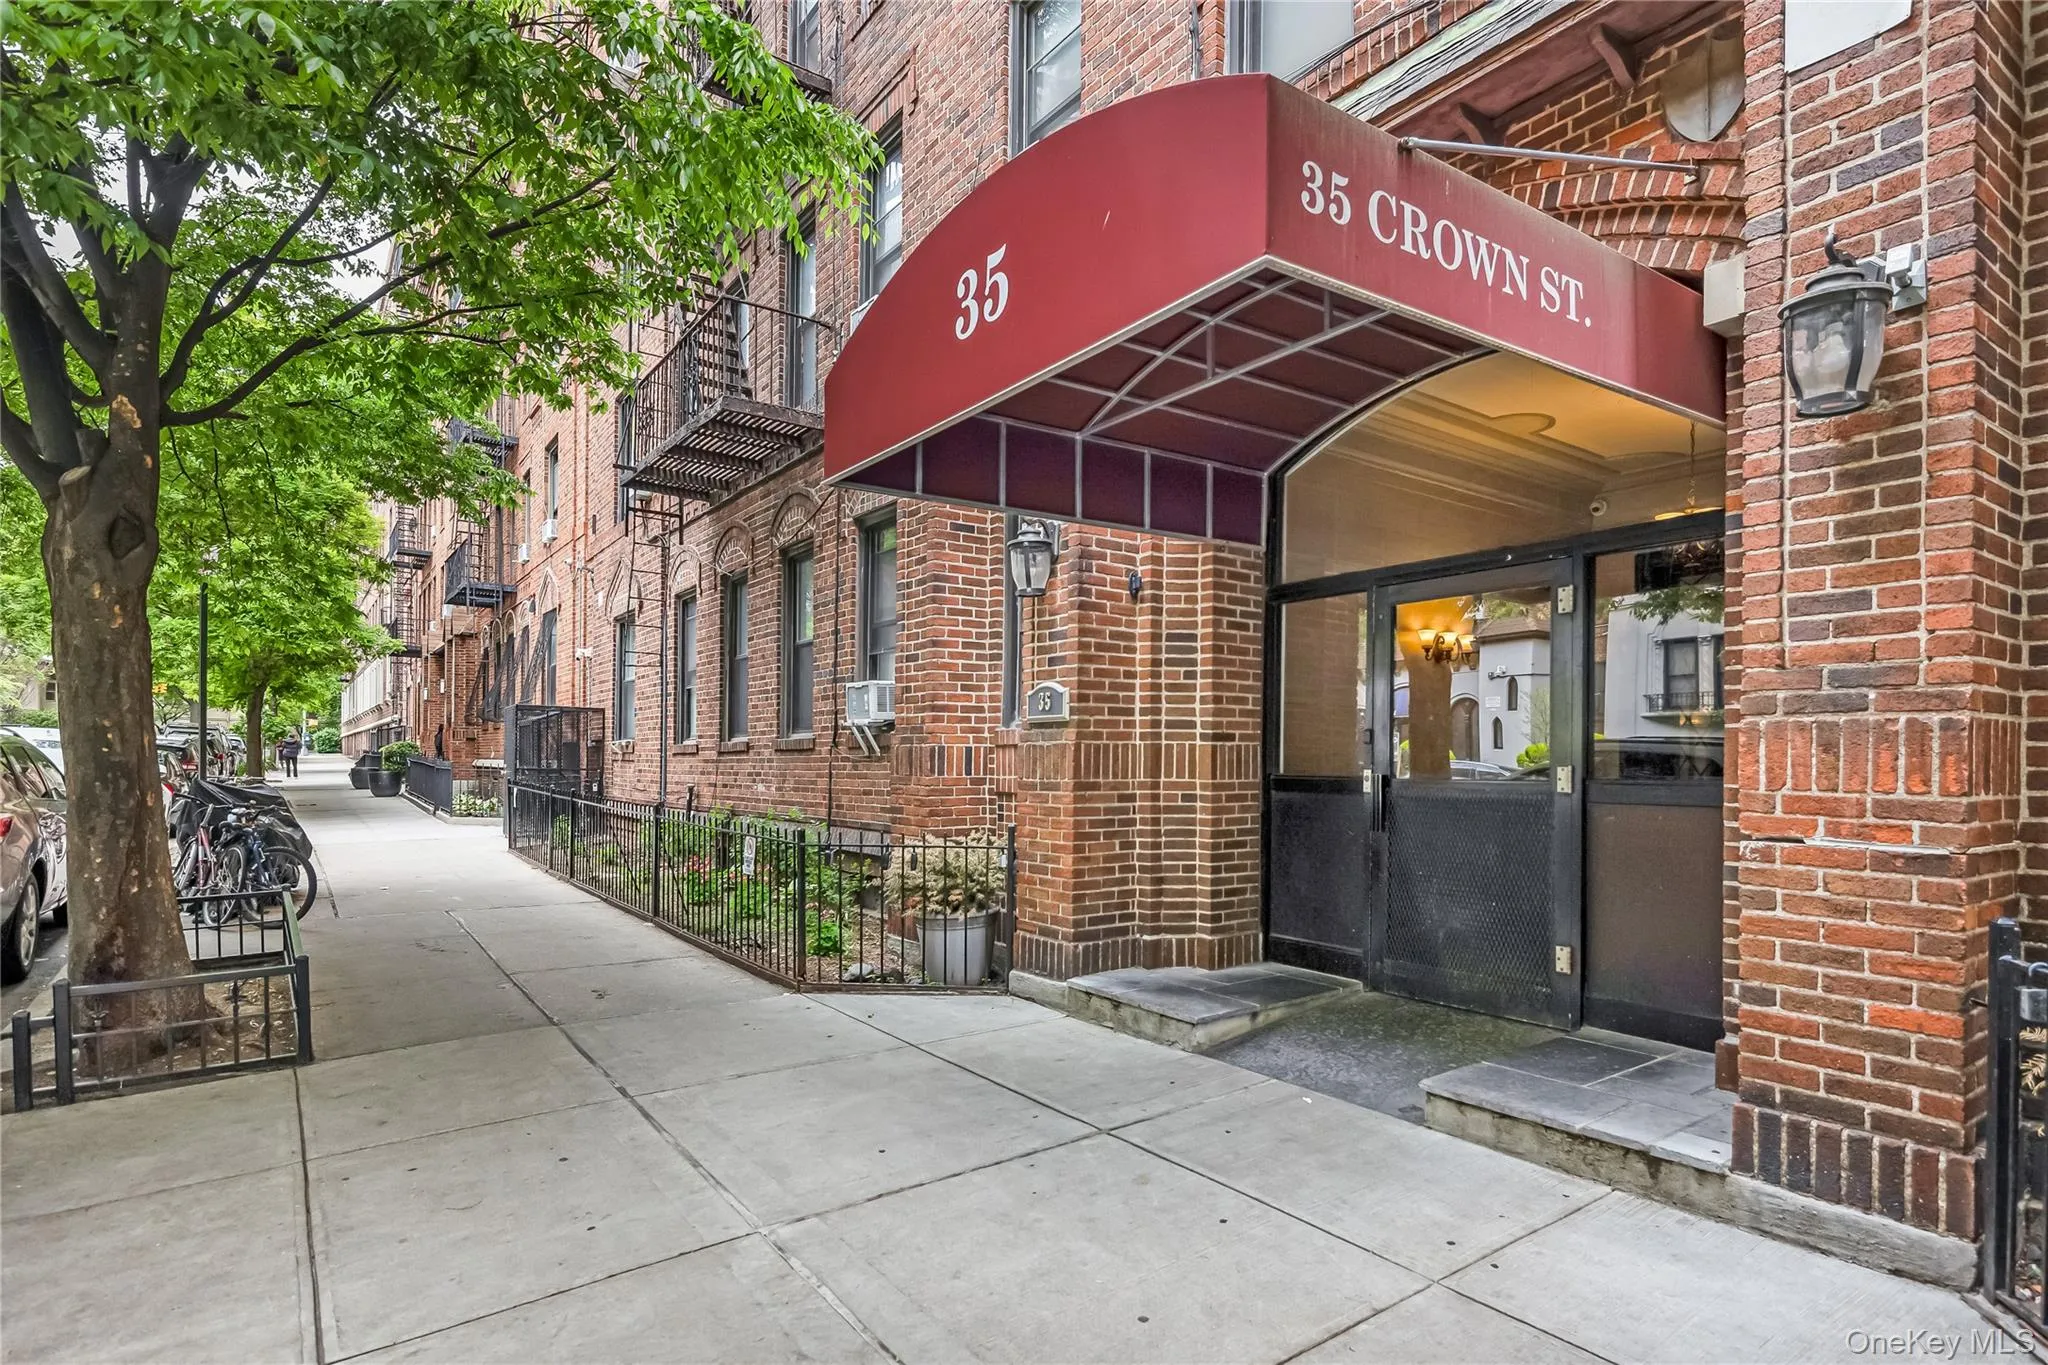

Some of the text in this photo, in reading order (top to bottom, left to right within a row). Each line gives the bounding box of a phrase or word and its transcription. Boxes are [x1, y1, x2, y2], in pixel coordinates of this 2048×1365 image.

[955, 243, 1009, 340] 35
[1301, 160, 1592, 328] 35 CROWN ST.
[1038, 692, 1051, 711] 35
